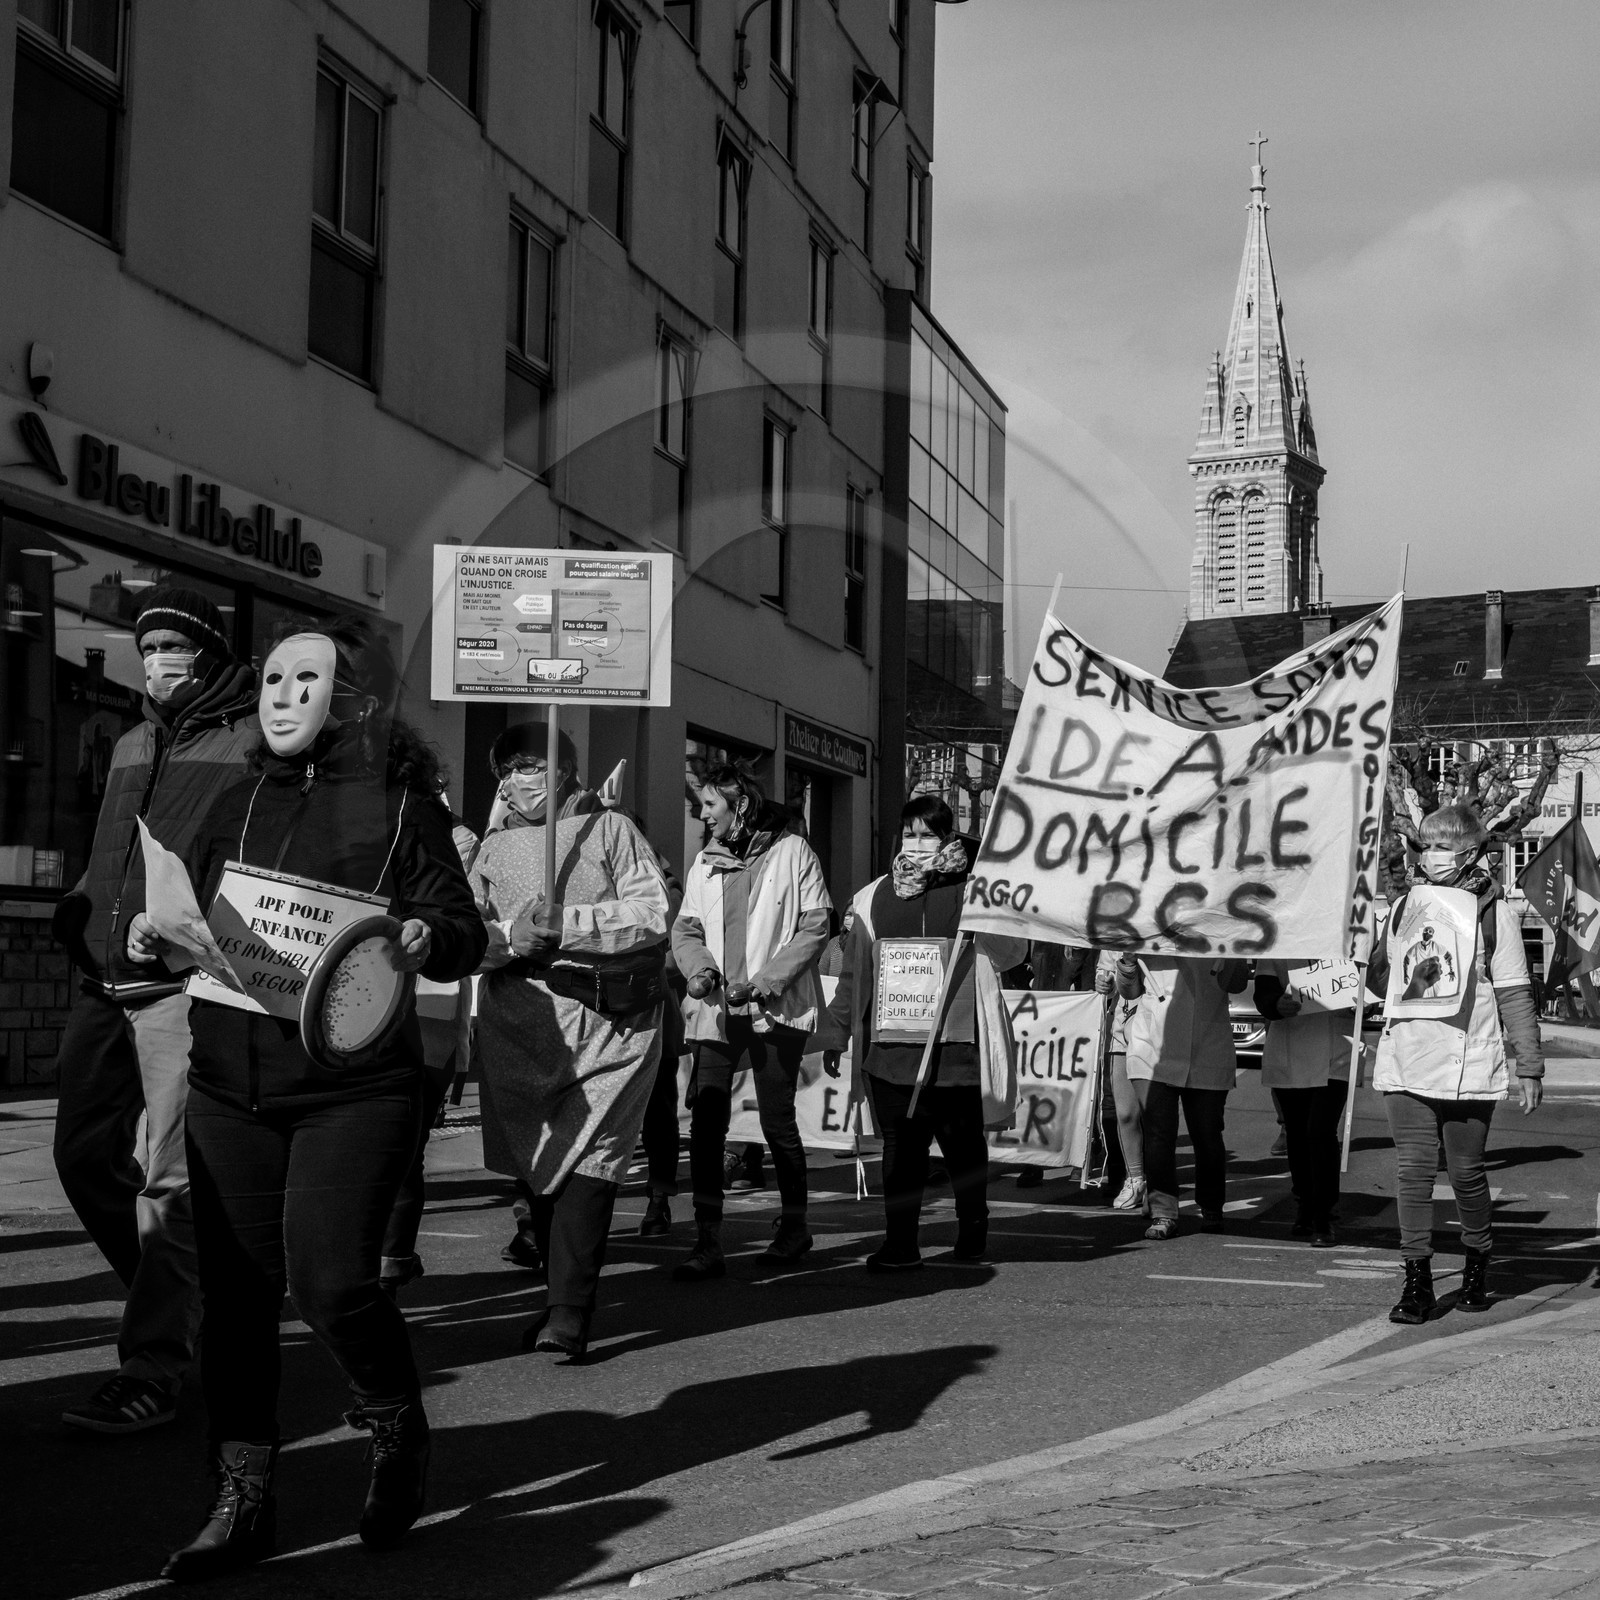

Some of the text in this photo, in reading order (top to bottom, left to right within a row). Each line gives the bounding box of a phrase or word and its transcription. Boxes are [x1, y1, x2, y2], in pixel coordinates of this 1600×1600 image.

[78, 434, 323, 577] Bleu Libellule
[461, 555, 549, 566] ON NE SAIT JAMAIS
[581, 562, 619, 570] qualification
[461, 567, 547, 578] QUAND ON CROISE
[620, 571, 640, 579] inégal
[460, 580, 515, 590] L'INJUSTICE.
[585, 622, 604, 630] Ségur
[458, 640, 477, 648] Ségur
[789, 720, 865, 771] Atelier de Couture
[254, 895, 335, 924] APF POLE
[249, 917, 328, 947] ENFANCE
[241, 943, 312, 972] INVISIBL
[889, 951, 940, 961] SOIGNANT
[893, 965, 934, 975] EN PERIL
[246, 971, 304, 996] SEGUR
[1331, 972, 1360, 995] DES
[888, 993, 936, 1003] DOMICILE
[887, 1008, 907, 1017] SUR
[909, 1008, 919, 1017] LE
[1012, 993, 1039, 1022] A
[1015, 1027, 1091, 1081] ICILE
